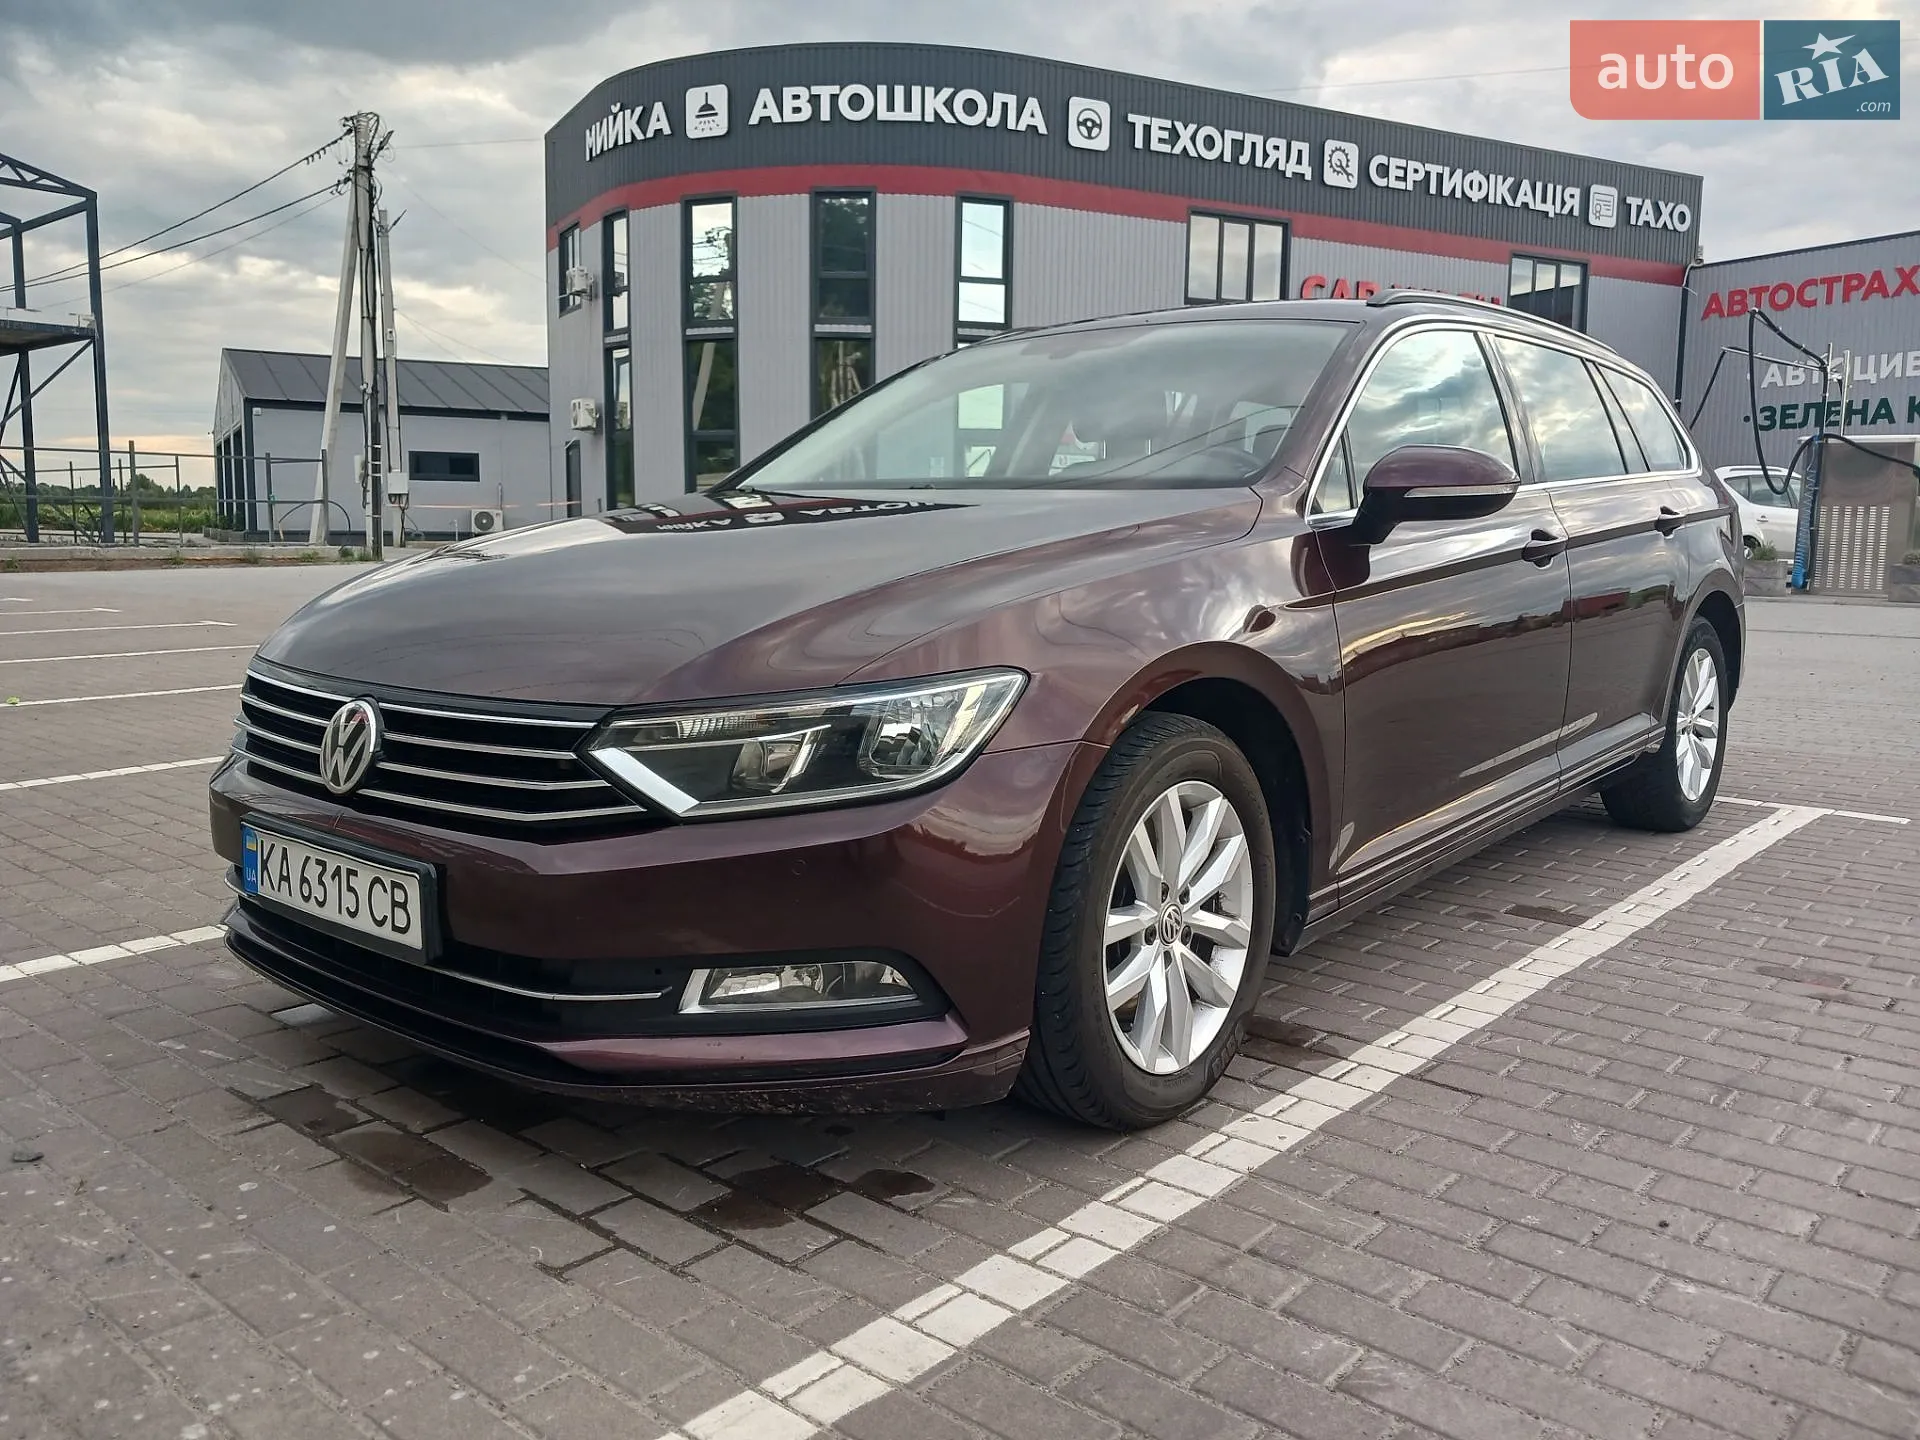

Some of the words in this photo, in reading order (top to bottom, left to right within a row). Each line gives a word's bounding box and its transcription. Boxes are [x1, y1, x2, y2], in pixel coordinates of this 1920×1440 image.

[585, 101, 672, 162] МИЙКА
[747, 84, 1048, 135] АВТОШКОЛА
[1127, 112, 1312, 181] ТЕХОГЛЯД
[1368, 154, 1580, 219] СЕРТИФІКАЦІЯ
[1626, 195, 1691, 233] ТАХО
[1701, 264, 1920, 321] АВТОСТРАХ
[1758, 397, 1896, 432] ЗЕЛЕНА
[245, 869, 257, 884] UA
[260, 839, 293, 897] KA
[299, 855, 360, 919] 6315
[367, 875, 412, 935] CB
